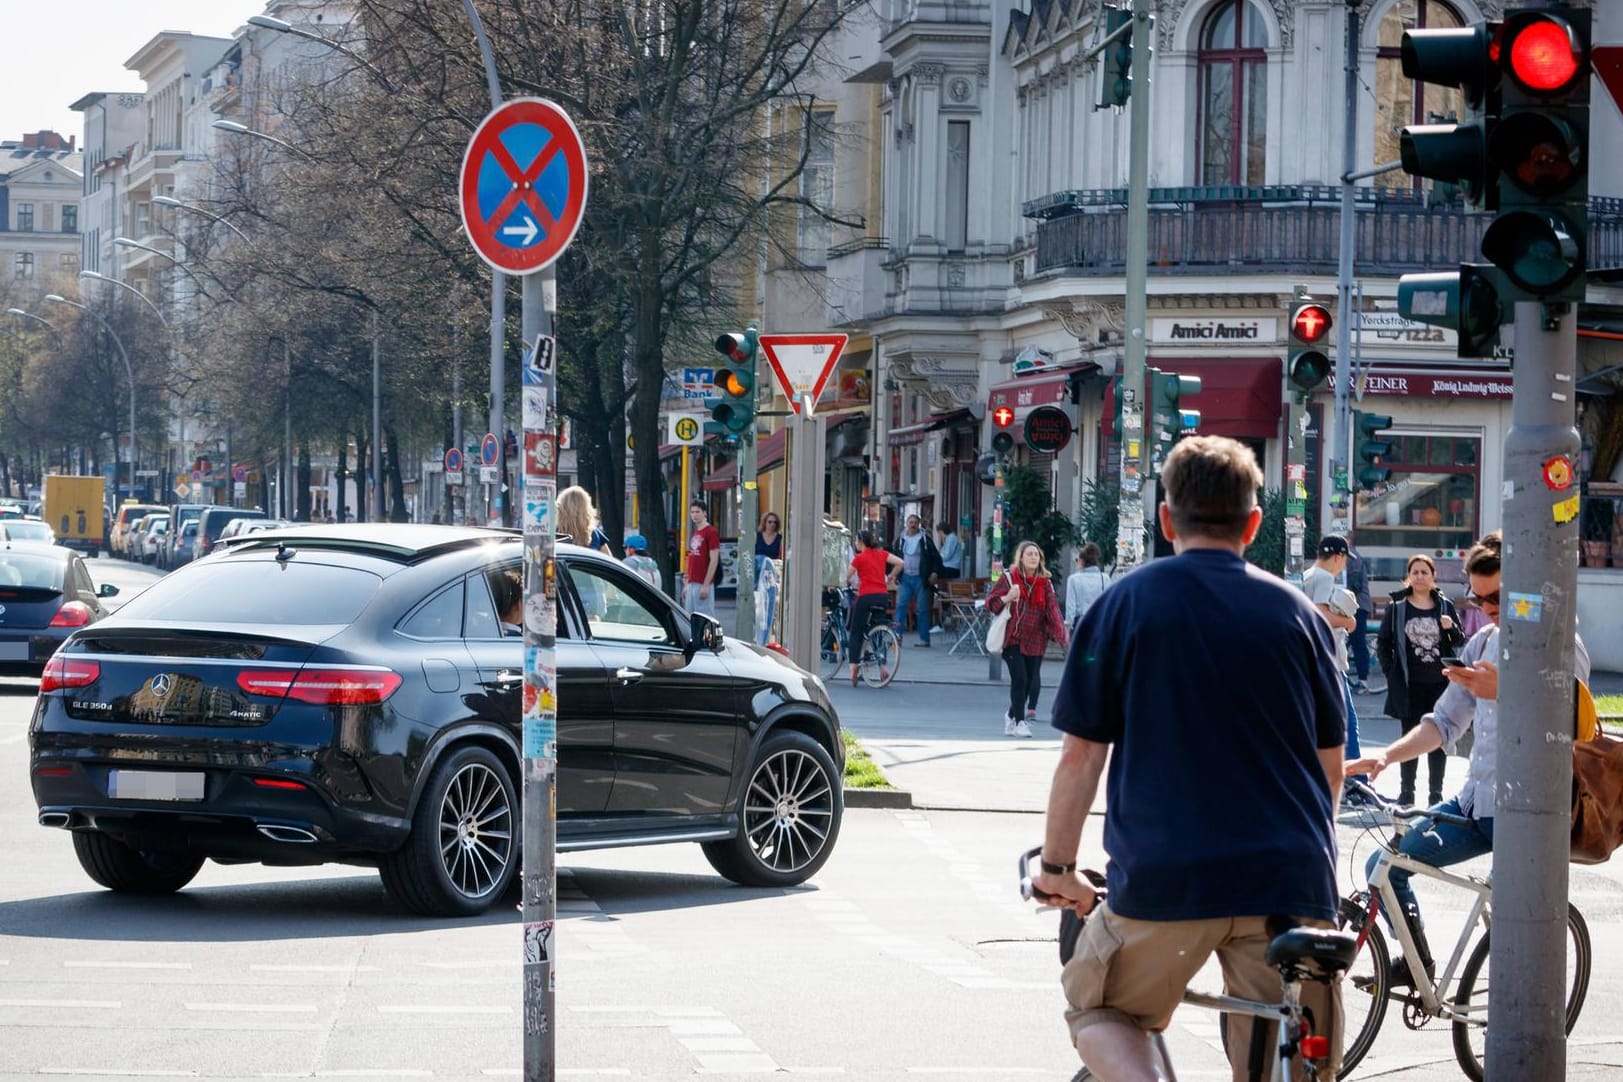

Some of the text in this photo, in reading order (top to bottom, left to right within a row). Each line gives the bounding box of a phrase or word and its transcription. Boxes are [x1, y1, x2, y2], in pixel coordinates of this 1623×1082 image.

[1170, 321, 1258, 339] Amici Amici
[1326, 375, 1409, 390] WREINER
[684, 389, 712, 399] Bank
[72, 701, 88, 709] GLE
[230, 710, 261, 718] 4MATIC
